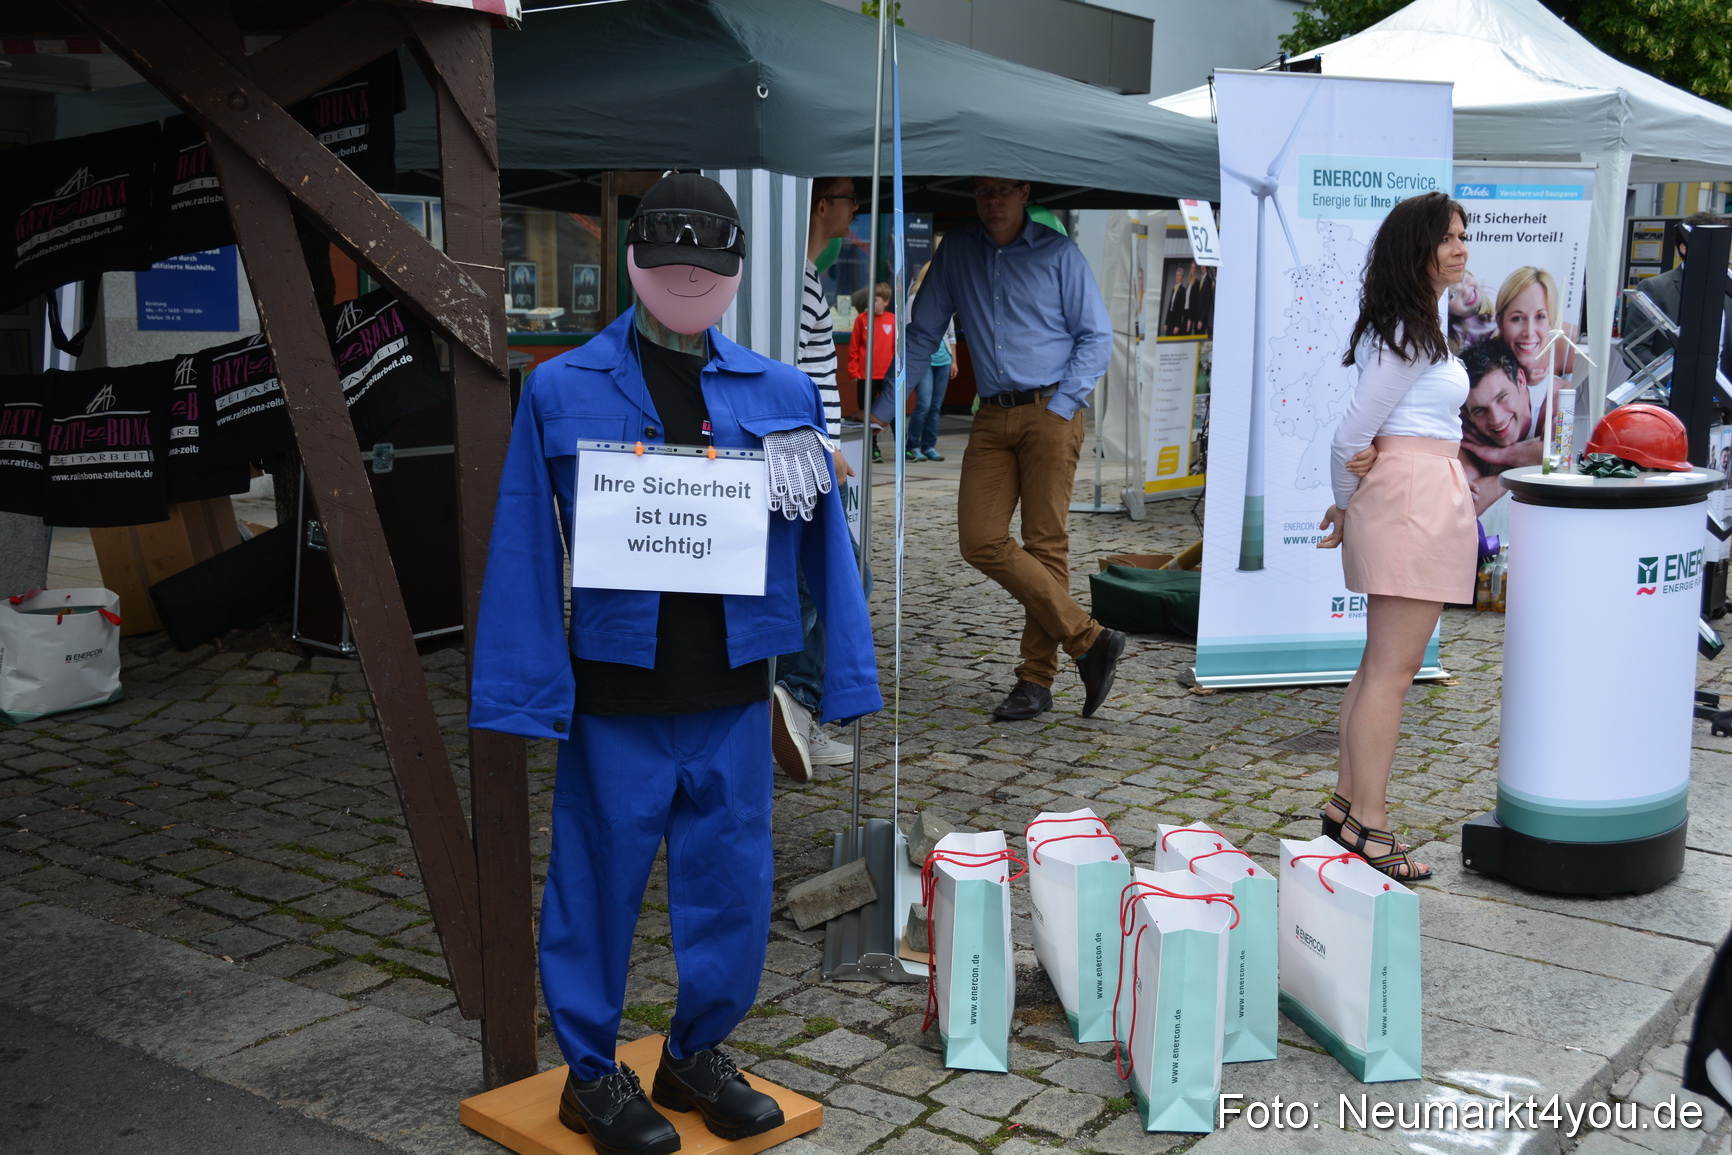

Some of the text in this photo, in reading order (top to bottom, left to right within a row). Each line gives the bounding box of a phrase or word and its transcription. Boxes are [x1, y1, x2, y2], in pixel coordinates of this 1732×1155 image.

[1313, 169, 1440, 191] ENERCON Service.
[1312, 193, 1351, 210] Energie
[1353, 194, 1368, 208] für
[1370, 195, 1392, 208] Ihre
[1500, 189, 1532, 199] Versichern
[1533, 189, 1544, 199] und
[1545, 189, 1578, 201] Bausparen
[1484, 213, 1547, 224] Sicherheit
[1191, 225, 1213, 253] 52
[1476, 231, 1513, 242] Ihrem
[48, 417, 152, 451] RATISBONA
[53, 452, 146, 464] ZEITARBEIT
[52, 470, 153, 482] www.ratisbona-zeitarbeit.de
[594, 474, 751, 499] Ihre Sicherheit
[635, 506, 708, 527] ist uns
[1283, 522, 1315, 532] ENERCON
[627, 535, 712, 559] wichtig!
[1663, 546, 1705, 583] ENER
[1662, 580, 1694, 594] ENERGIE
[73, 648, 104, 661] ENERCON
[1299, 928, 1326, 956] ENERCON
[1095, 932, 1103, 1001] www.enercon.de
[970, 953, 980, 1026] www.enercon.de
[1238, 950, 1246, 1019] www.enercon.de
[1171, 1009, 1182, 1085] www.enercon.de
